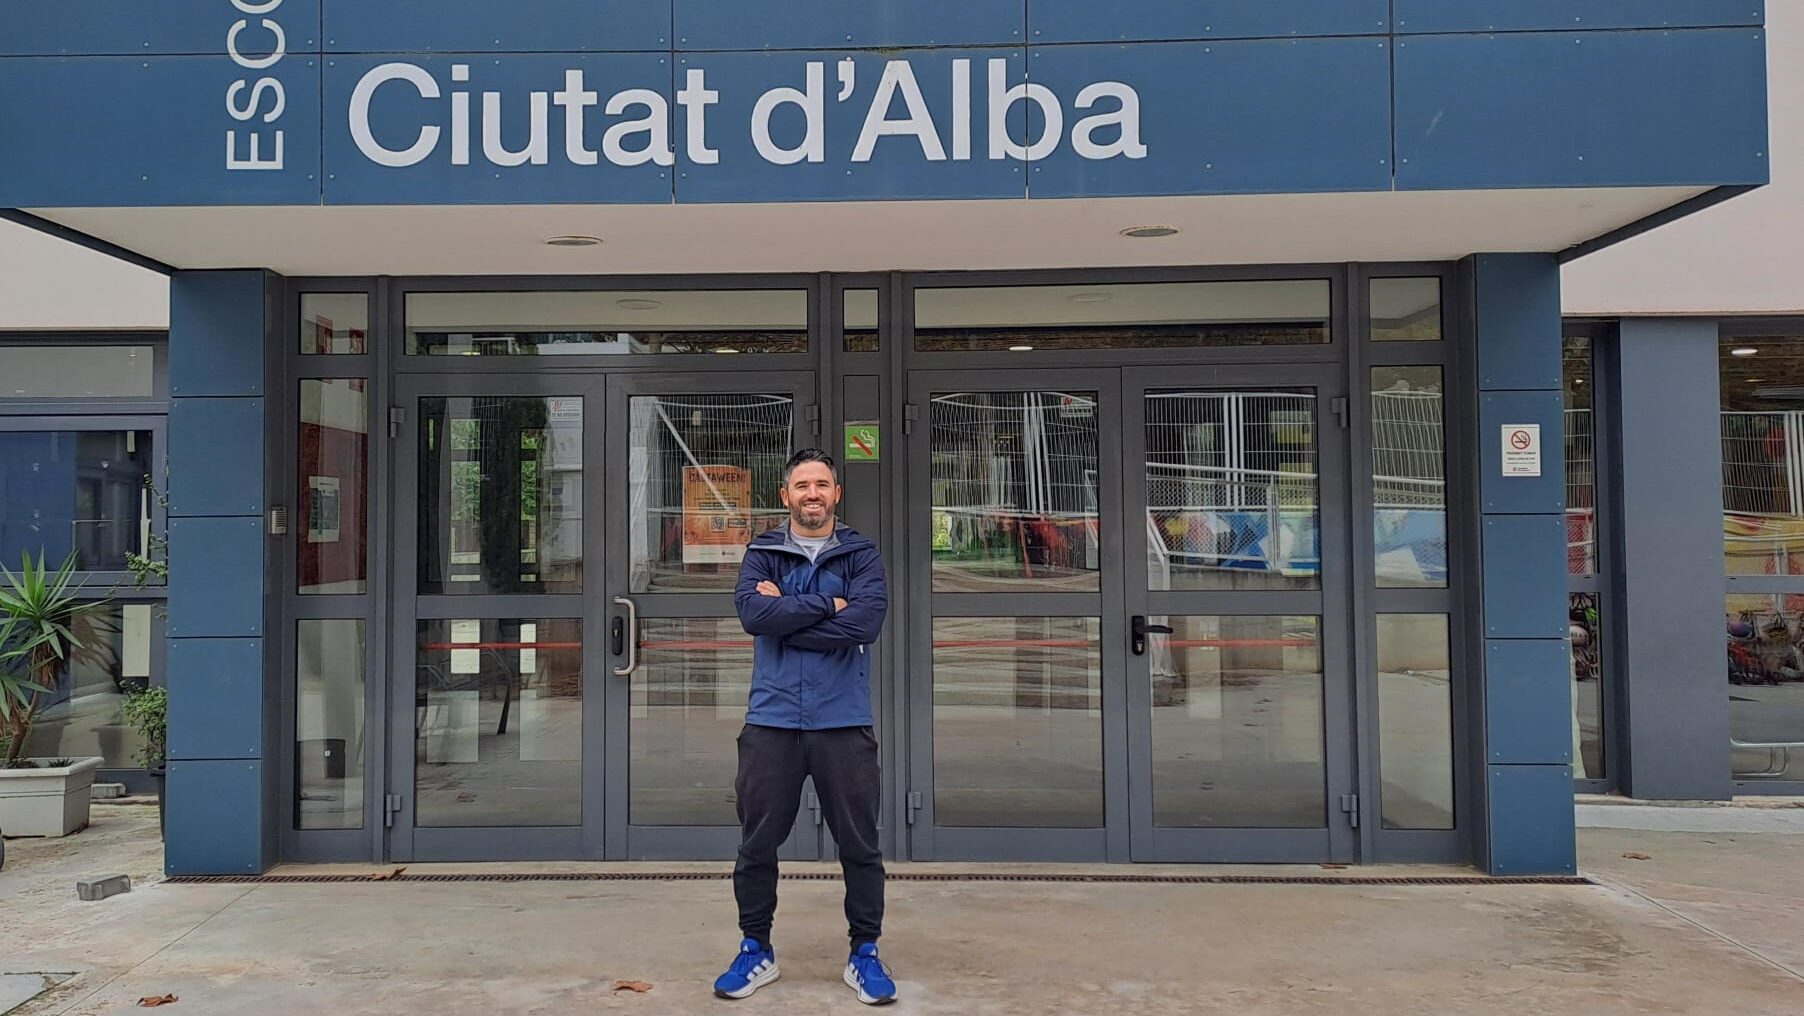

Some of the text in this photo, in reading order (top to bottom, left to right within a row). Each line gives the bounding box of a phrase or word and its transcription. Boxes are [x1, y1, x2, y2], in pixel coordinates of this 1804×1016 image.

[226, 0, 285, 169] ESC
[348, 57, 1148, 167] Ciutat d’Alba
